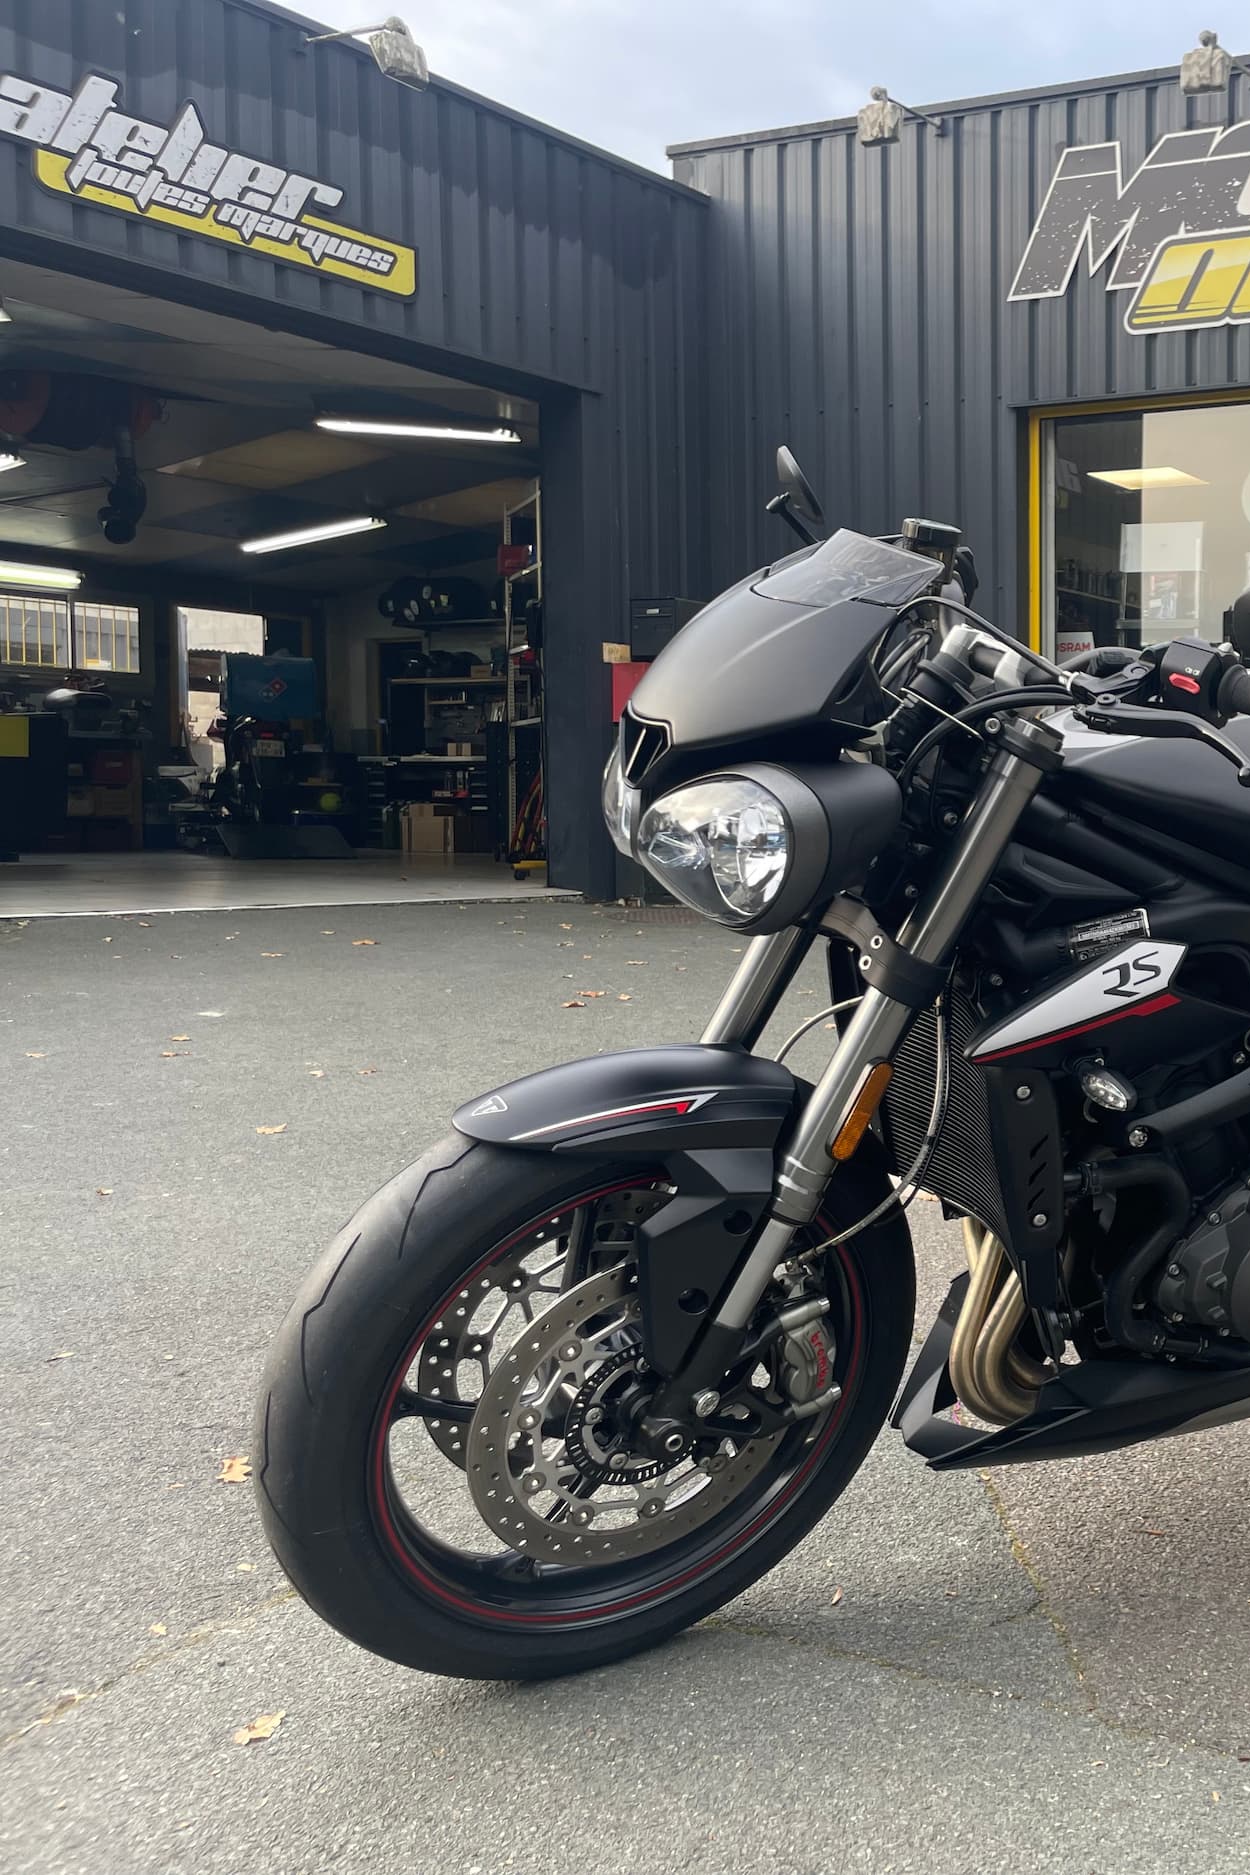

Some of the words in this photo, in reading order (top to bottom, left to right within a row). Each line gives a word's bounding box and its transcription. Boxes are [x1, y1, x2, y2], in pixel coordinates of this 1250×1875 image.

[0, 75, 344, 220] atelier
[69, 149, 211, 211] toutes
[216, 203, 394, 273] marques
[1102, 950, 1162, 998] RS
[810, 1330, 828, 1388] brembo
